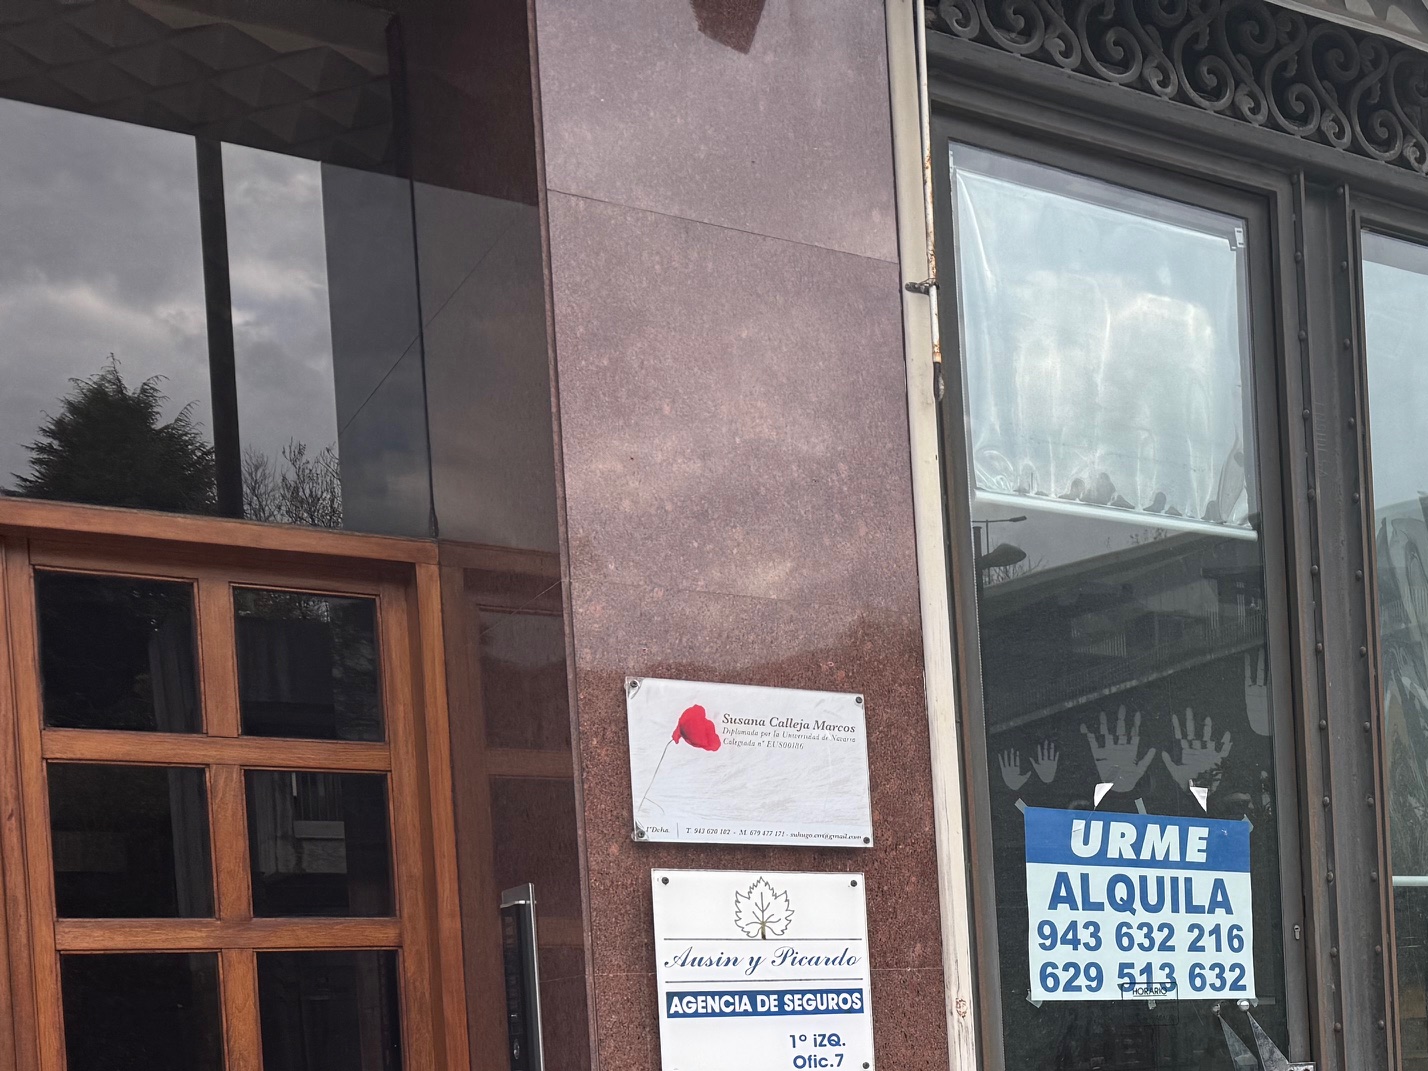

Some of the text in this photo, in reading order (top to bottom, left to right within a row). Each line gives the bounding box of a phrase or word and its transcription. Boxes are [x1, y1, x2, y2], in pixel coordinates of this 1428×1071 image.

[722, 712, 856, 734] Susana Calleja Marcos
[722, 727, 759, 737] Diplomada
[760, 731, 771, 739] por
[773, 730, 780, 738] la
[782, 730, 820, 741] Universidad
[830, 735, 856, 743] Navarra
[723, 737, 756, 748] Colegiada
[1070, 819, 1210, 863] URME
[1047, 871, 1234, 916] ALQUILA
[1037, 920, 1245, 954] 943 632 216
[744, 955, 766, 976] y
[771, 946, 862, 967] Picardo
[1039, 961, 1248, 993] 629 513 632
[1132, 986, 1168, 996] HORARIO
[669, 992, 862, 1015] AGENCIA DE SEGUROS
[789, 1034, 807, 1049] 1º
[792, 1053, 845, 1070] Ofic.7
